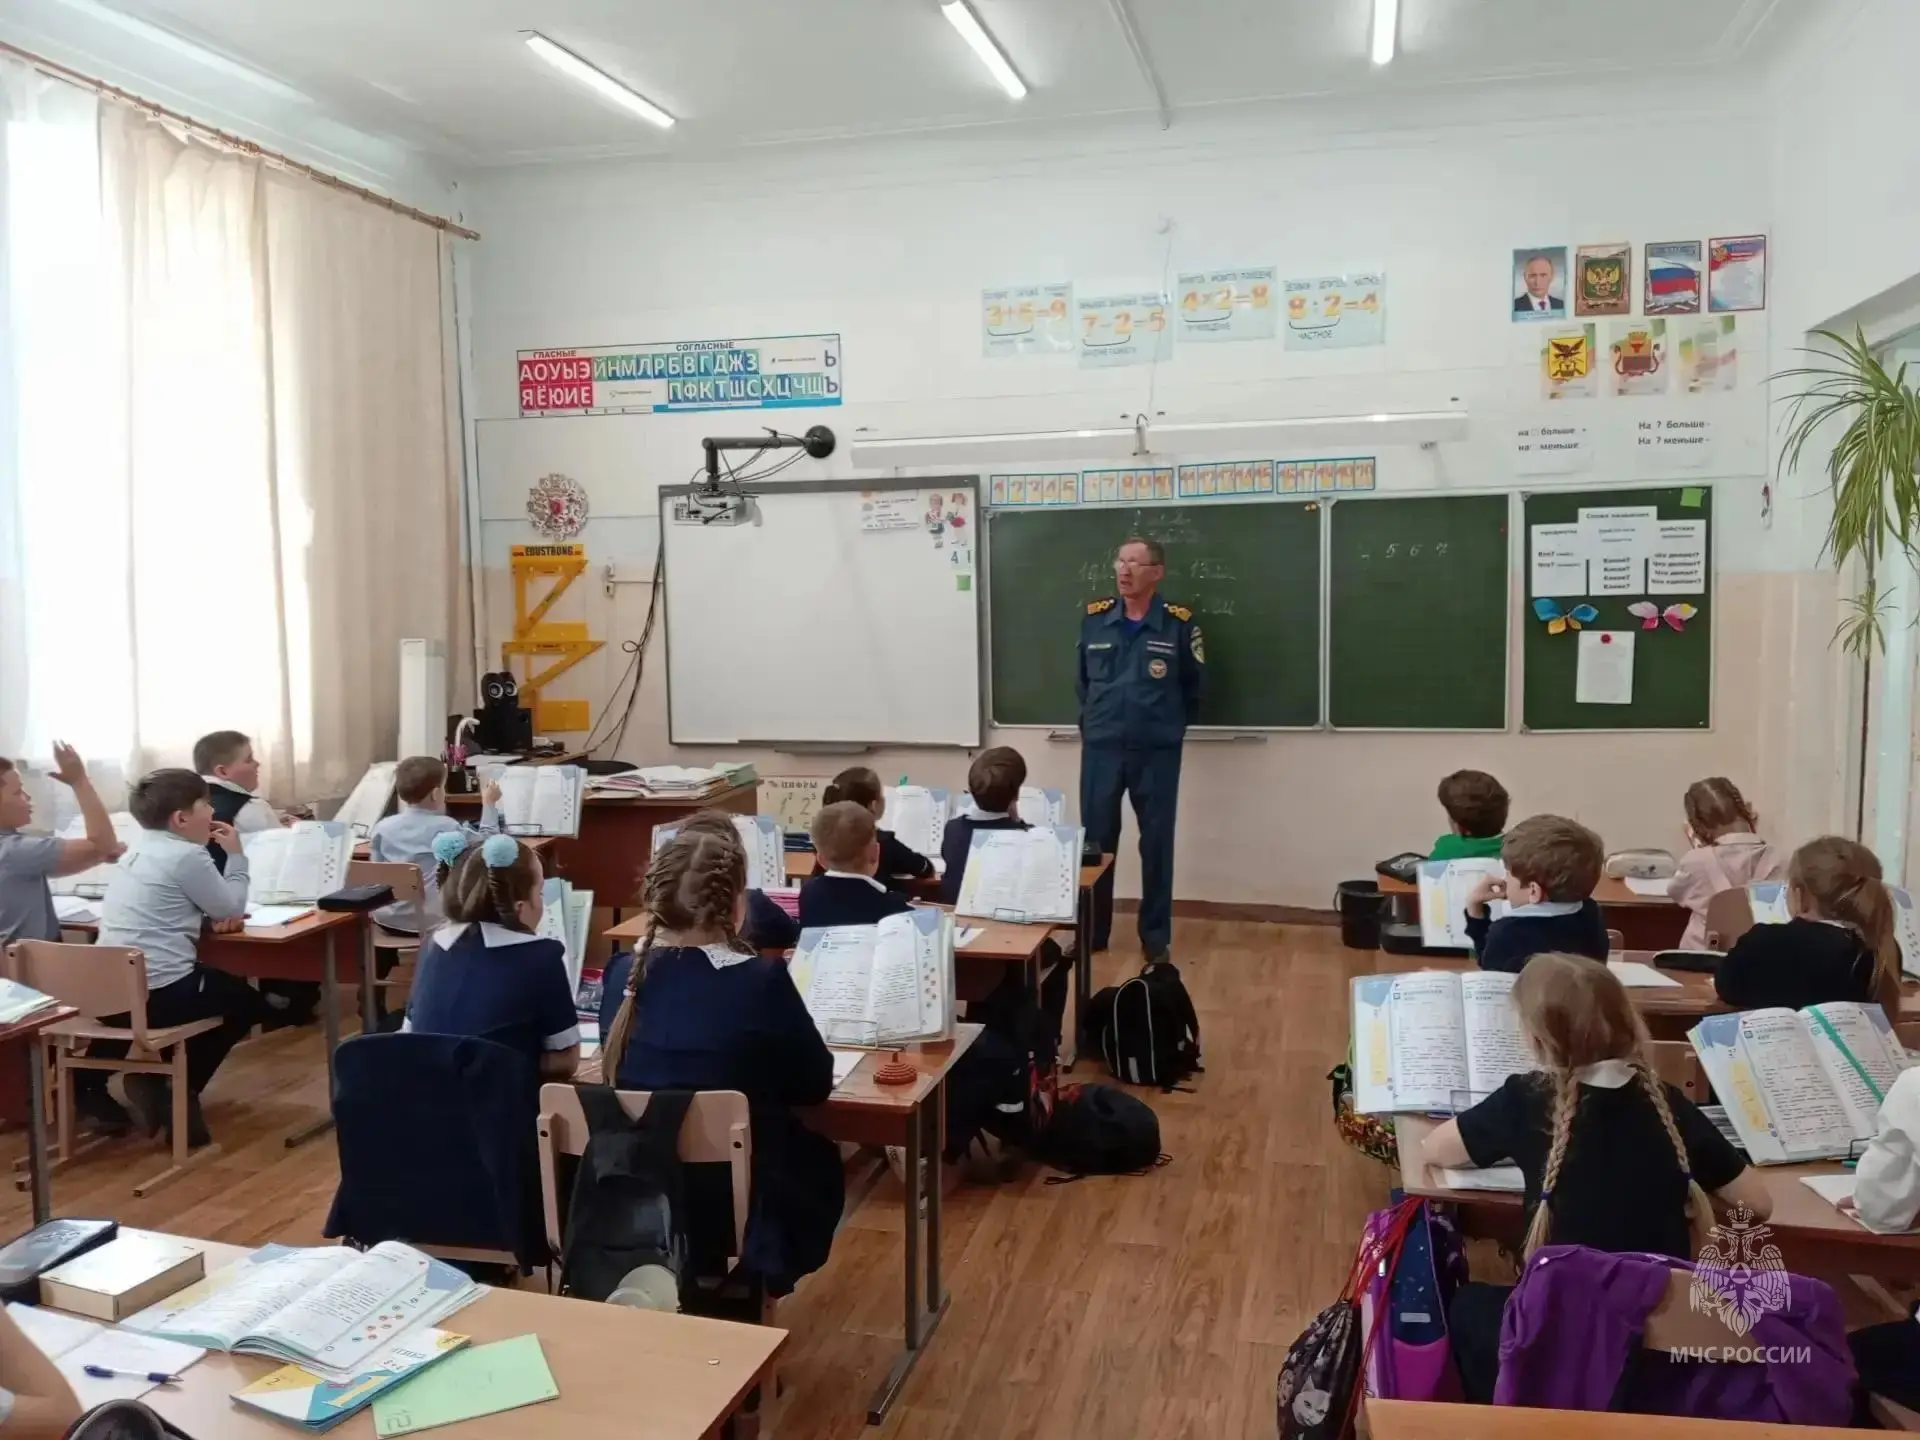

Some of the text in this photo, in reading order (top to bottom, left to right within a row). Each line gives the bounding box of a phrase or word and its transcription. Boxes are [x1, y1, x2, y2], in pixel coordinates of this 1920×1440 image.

[676, 341, 735, 352] СОГЛАСНЫЕ
[533, 350, 577, 359] ГЛАСНЫЕ
[1666, 419, 1705, 429] больше
[1541, 427, 1576, 438] больше
[1663, 437, 1704, 446] меньше
[525, 545, 573, 556] EDUSTRONG
